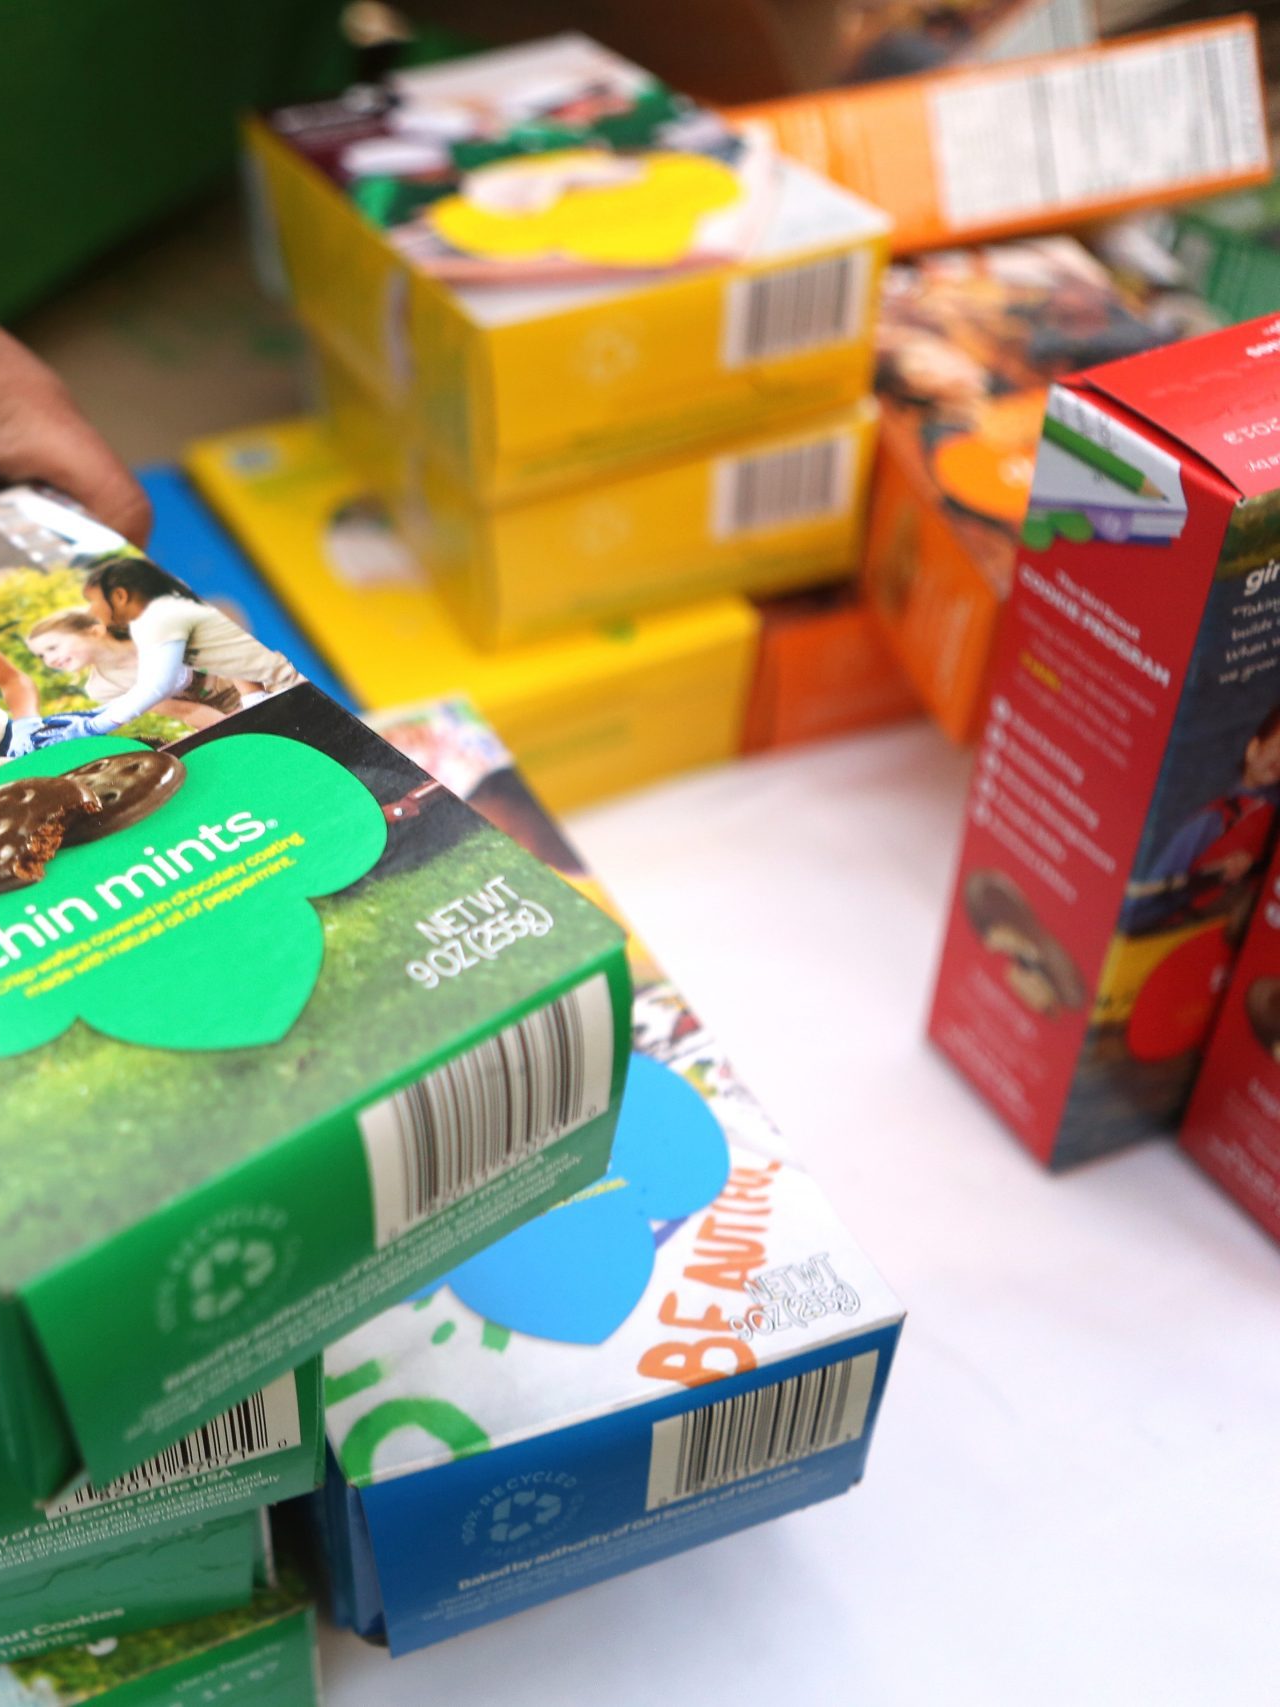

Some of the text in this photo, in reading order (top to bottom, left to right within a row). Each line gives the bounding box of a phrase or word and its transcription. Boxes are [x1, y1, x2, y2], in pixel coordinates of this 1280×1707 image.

[1244, 558, 1280, 596] gir
[1081, 611, 1171, 688] PROGRAM
[37, 942, 91, 973] wafers
[90, 907, 156, 946] covered
[154, 901, 172, 914] in
[246, 832, 305, 867] coating
[23, 968, 74, 999] made
[74, 950, 109, 973] with
[108, 921, 164, 956] natural
[164, 910, 185, 928] oil
[184, 901, 202, 918] of
[10, 1524, 31, 1541] of
[32, 1515, 67, 1535] Girl
[69, 1497, 134, 1525] Scouts
[135, 1489, 156, 1505] of
[159, 1479, 190, 1497] the
[192, 1466, 237, 1487] USA.
[235, 1469, 262, 1484] and
[480, 1470, 577, 1506] RECYCLED
[458, 1565, 511, 1591] Baked
[511, 1556, 532, 1573] by
[534, 1533, 609, 1564] authority
[610, 1522, 630, 1539] of
[632, 1513, 662, 1536] Girl
[663, 1495, 717, 1522] Scouts
[739, 1477, 763, 1496] the
[31, 1606, 125, 1637] Cookies
